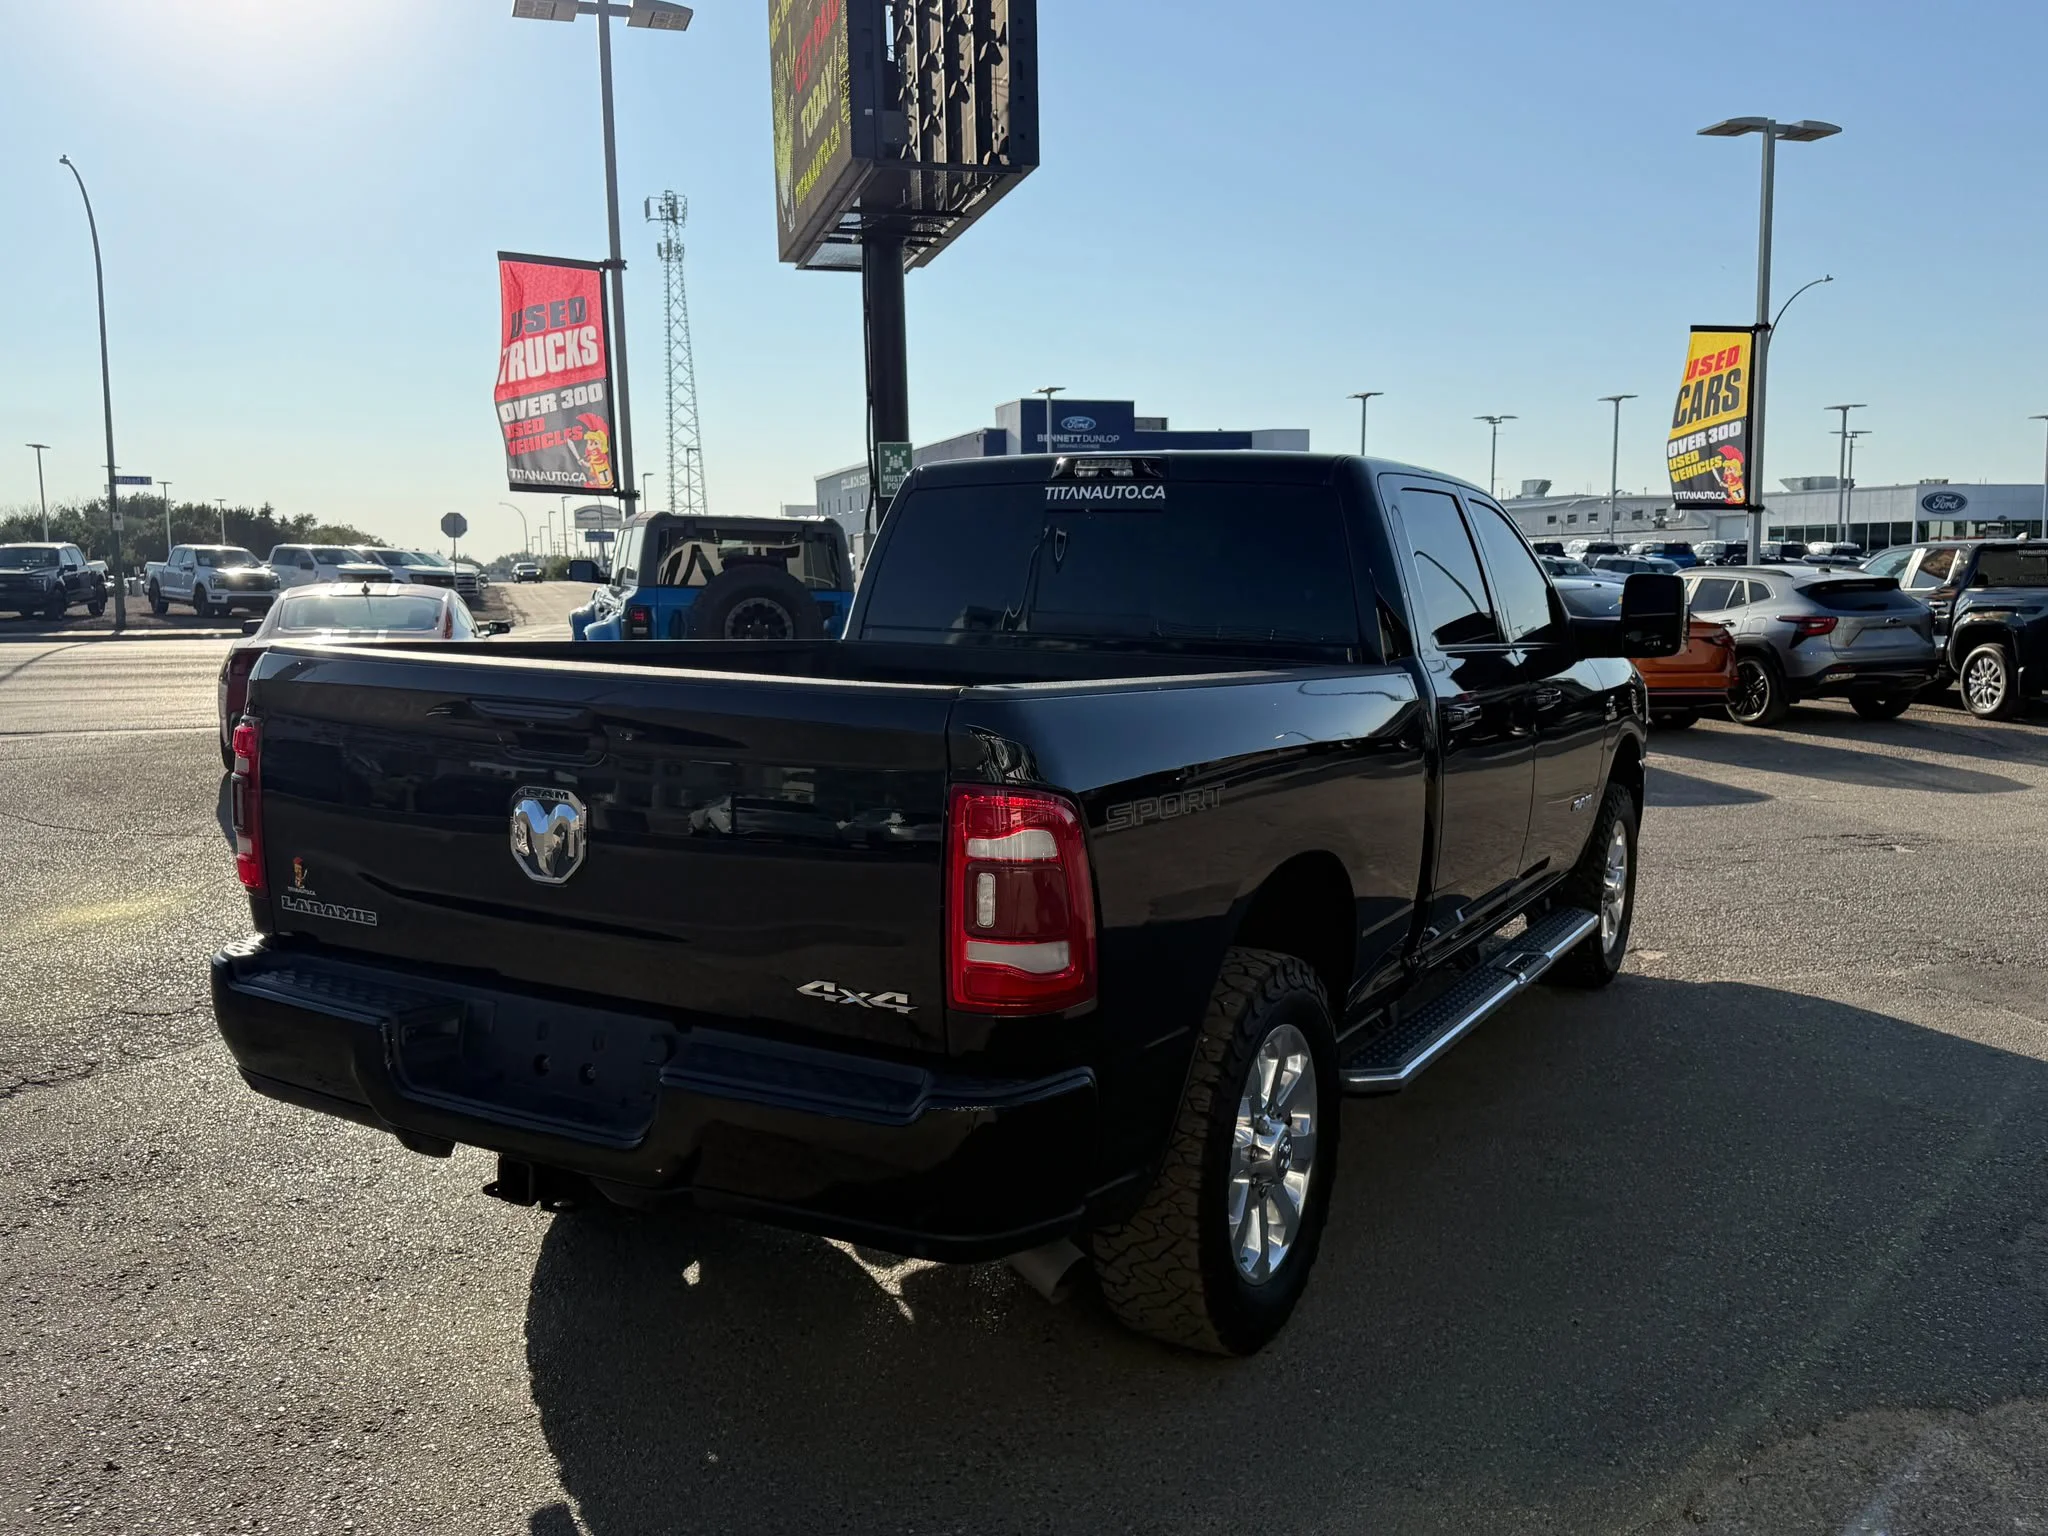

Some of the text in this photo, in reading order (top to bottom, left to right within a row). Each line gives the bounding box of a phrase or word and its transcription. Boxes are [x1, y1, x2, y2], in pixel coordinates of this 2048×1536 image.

[795, 30, 812, 93] GET
[511, 296, 587, 339] USED
[1686, 345, 1741, 381] USED
[500, 383, 604, 423] OVER 300
[1672, 367, 1741, 429] CARS
[504, 417, 545, 439] USED
[1066, 419, 1090, 429] Ford
[508, 425, 584, 457] VEHICLES
[1037, 434, 1120, 443] BENNETT DUNLOP
[1667, 421, 1742, 458] OVER 300
[1669, 450, 1699, 471] USED
[1671, 455, 1723, 483] VEHICLES
[510, 468, 588, 482] TITANAUTO.CA
[1044, 485, 1167, 500] TITANAUTO.CA
[1673, 491, 1728, 500] TITANAUTO.CA
[1932, 495, 1959, 509] Ford
[524, 788, 570, 801] RAM
[1106, 783, 1226, 832] SPORT
[281, 895, 378, 926] LARAMIE
